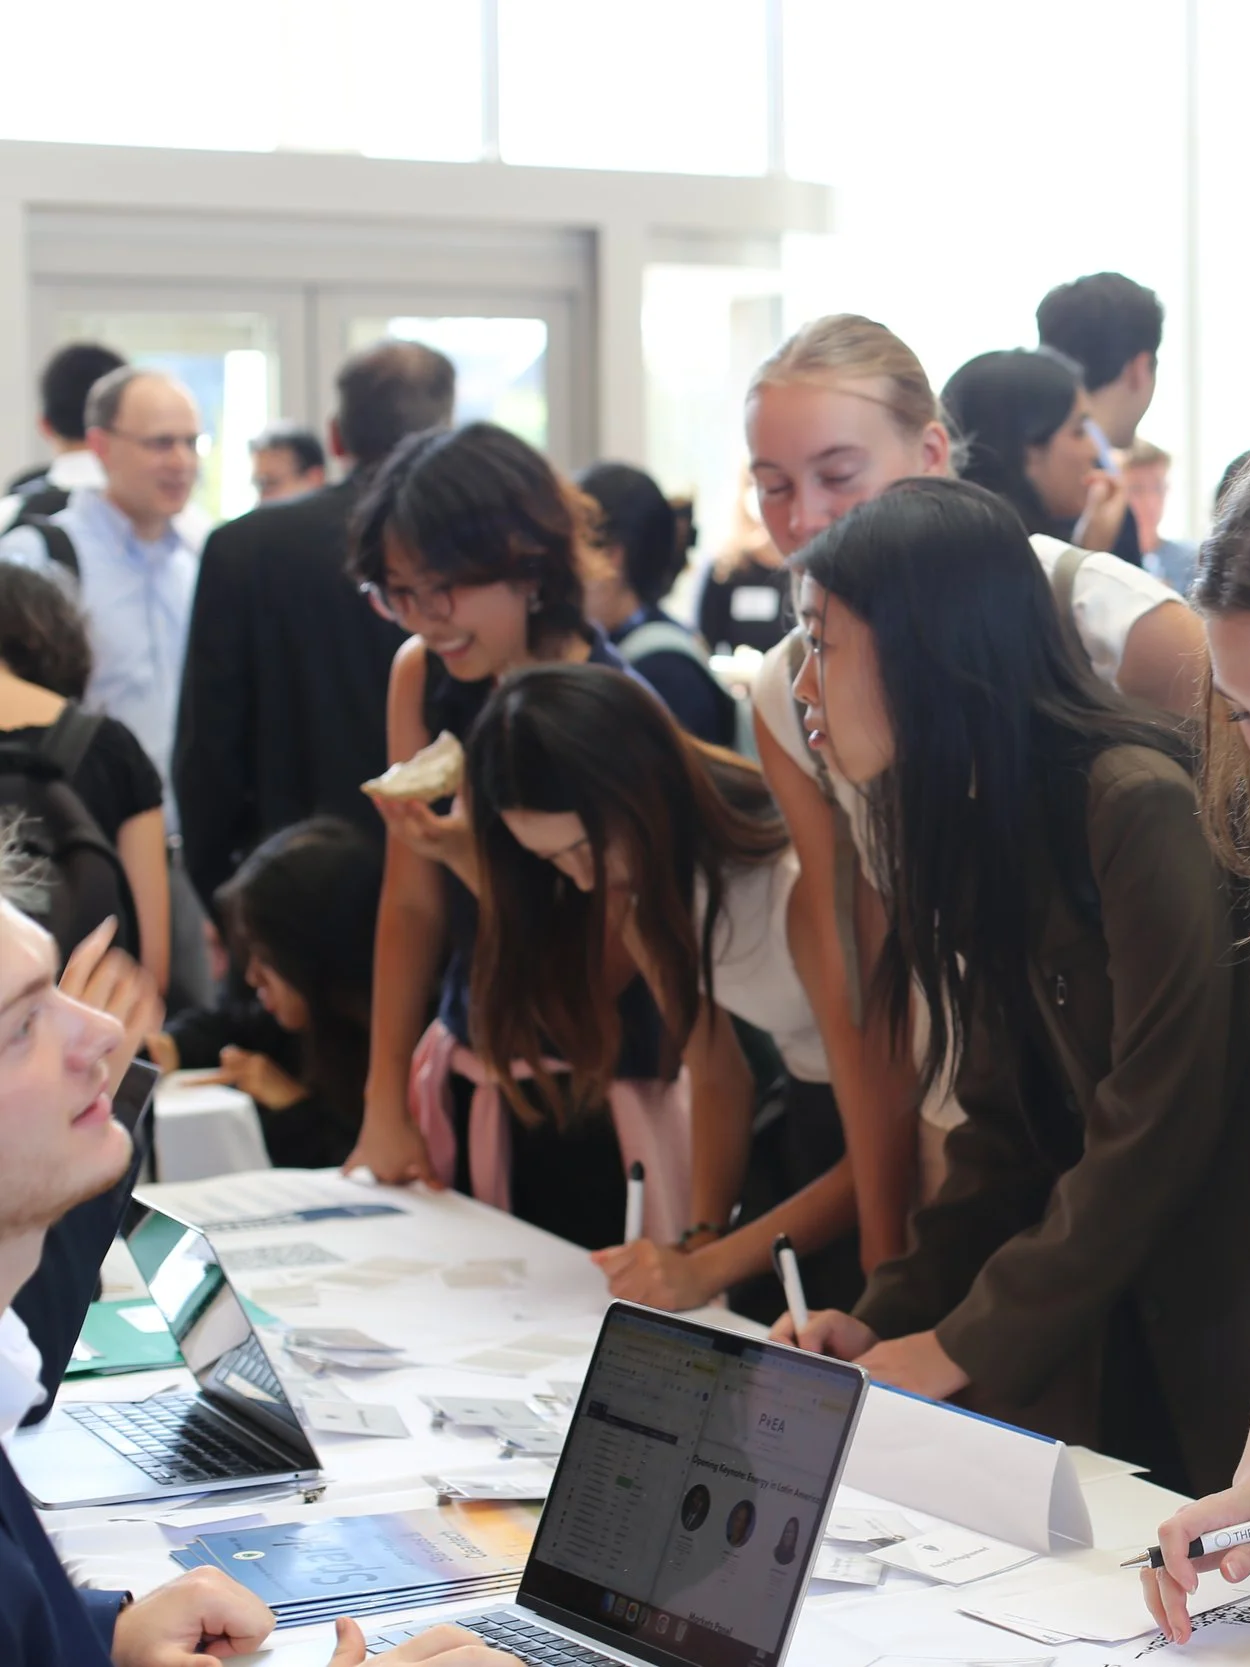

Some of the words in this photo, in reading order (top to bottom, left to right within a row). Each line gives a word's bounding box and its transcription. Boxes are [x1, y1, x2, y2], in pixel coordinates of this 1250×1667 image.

[692, 1454, 720, 1473] Opening
[746, 1472, 769, 1489] Energy
[776, 1481, 794, 1494] Latin
[271, 1534, 386, 1586] Spark
